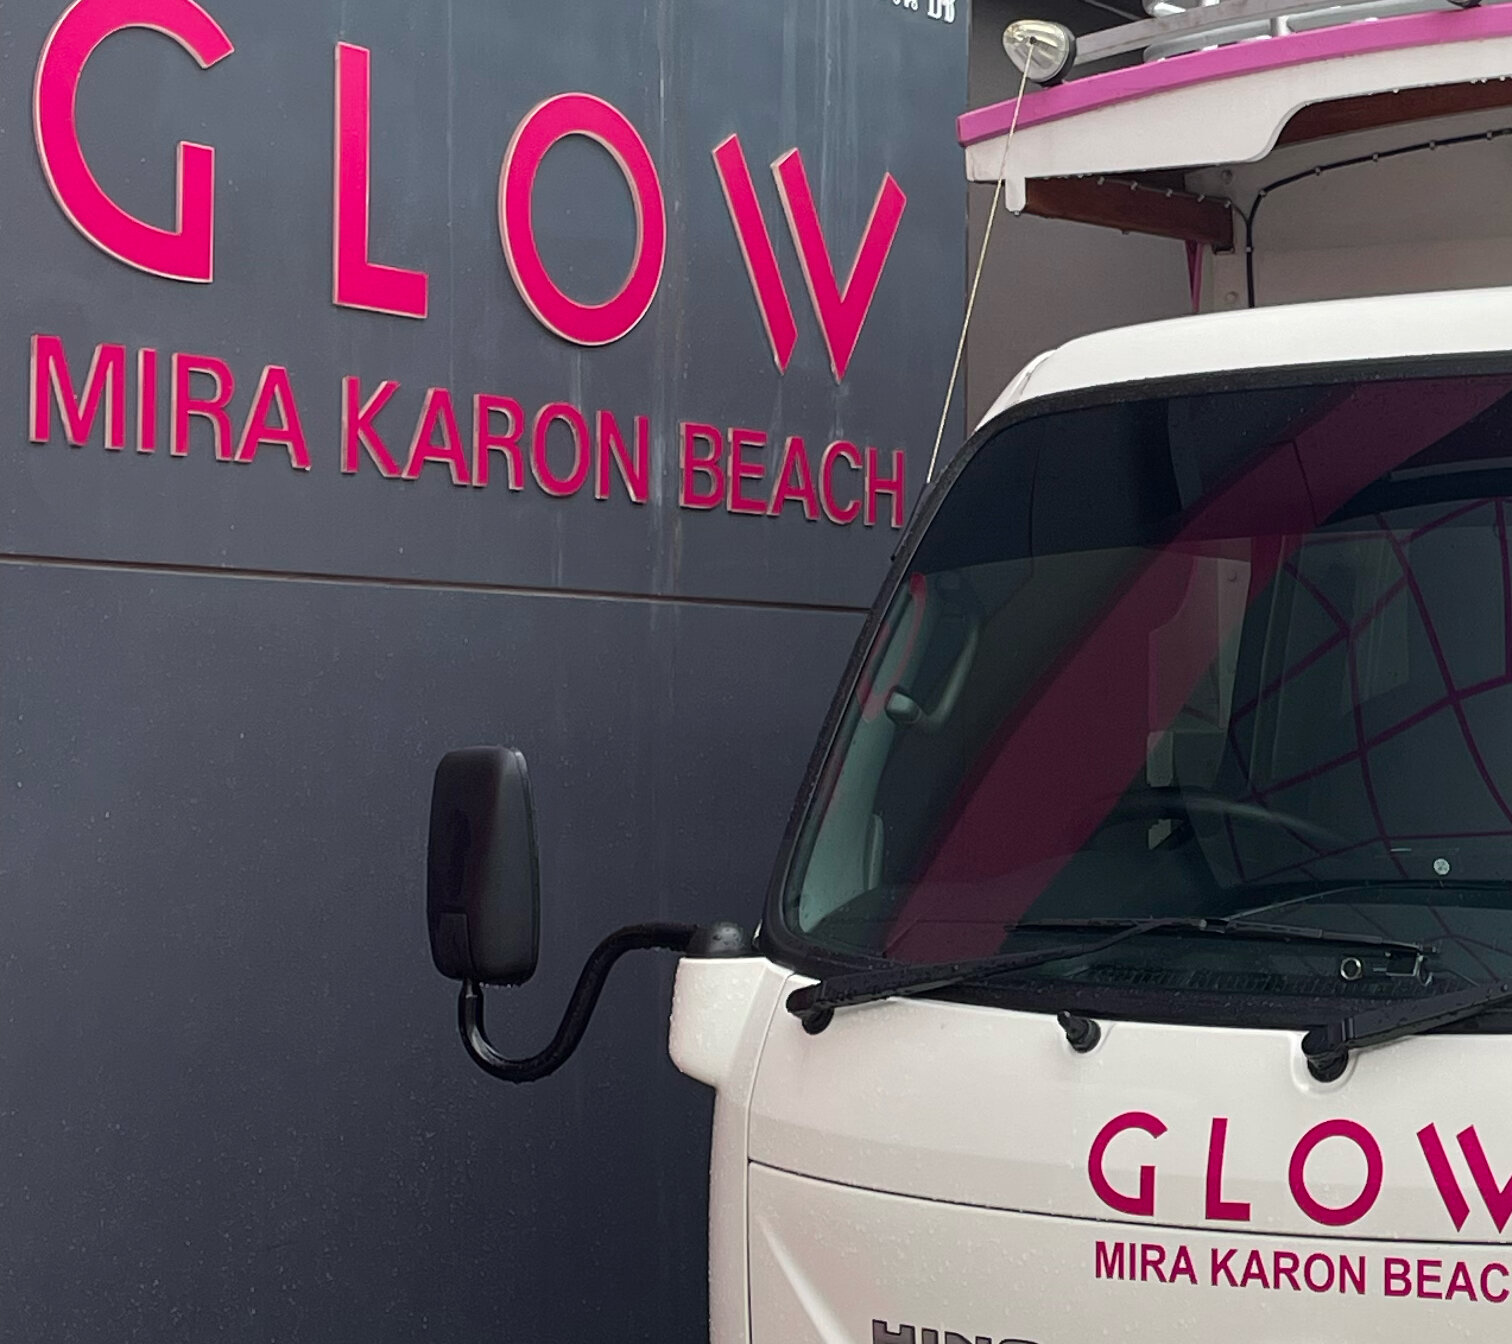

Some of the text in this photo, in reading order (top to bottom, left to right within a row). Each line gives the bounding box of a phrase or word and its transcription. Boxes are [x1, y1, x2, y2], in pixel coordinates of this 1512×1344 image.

[29, 333, 905, 529] MIRA KARON BEACH
[1095, 1241, 1198, 1285] MIRA
[1210, 1248, 1366, 1295] KARON
